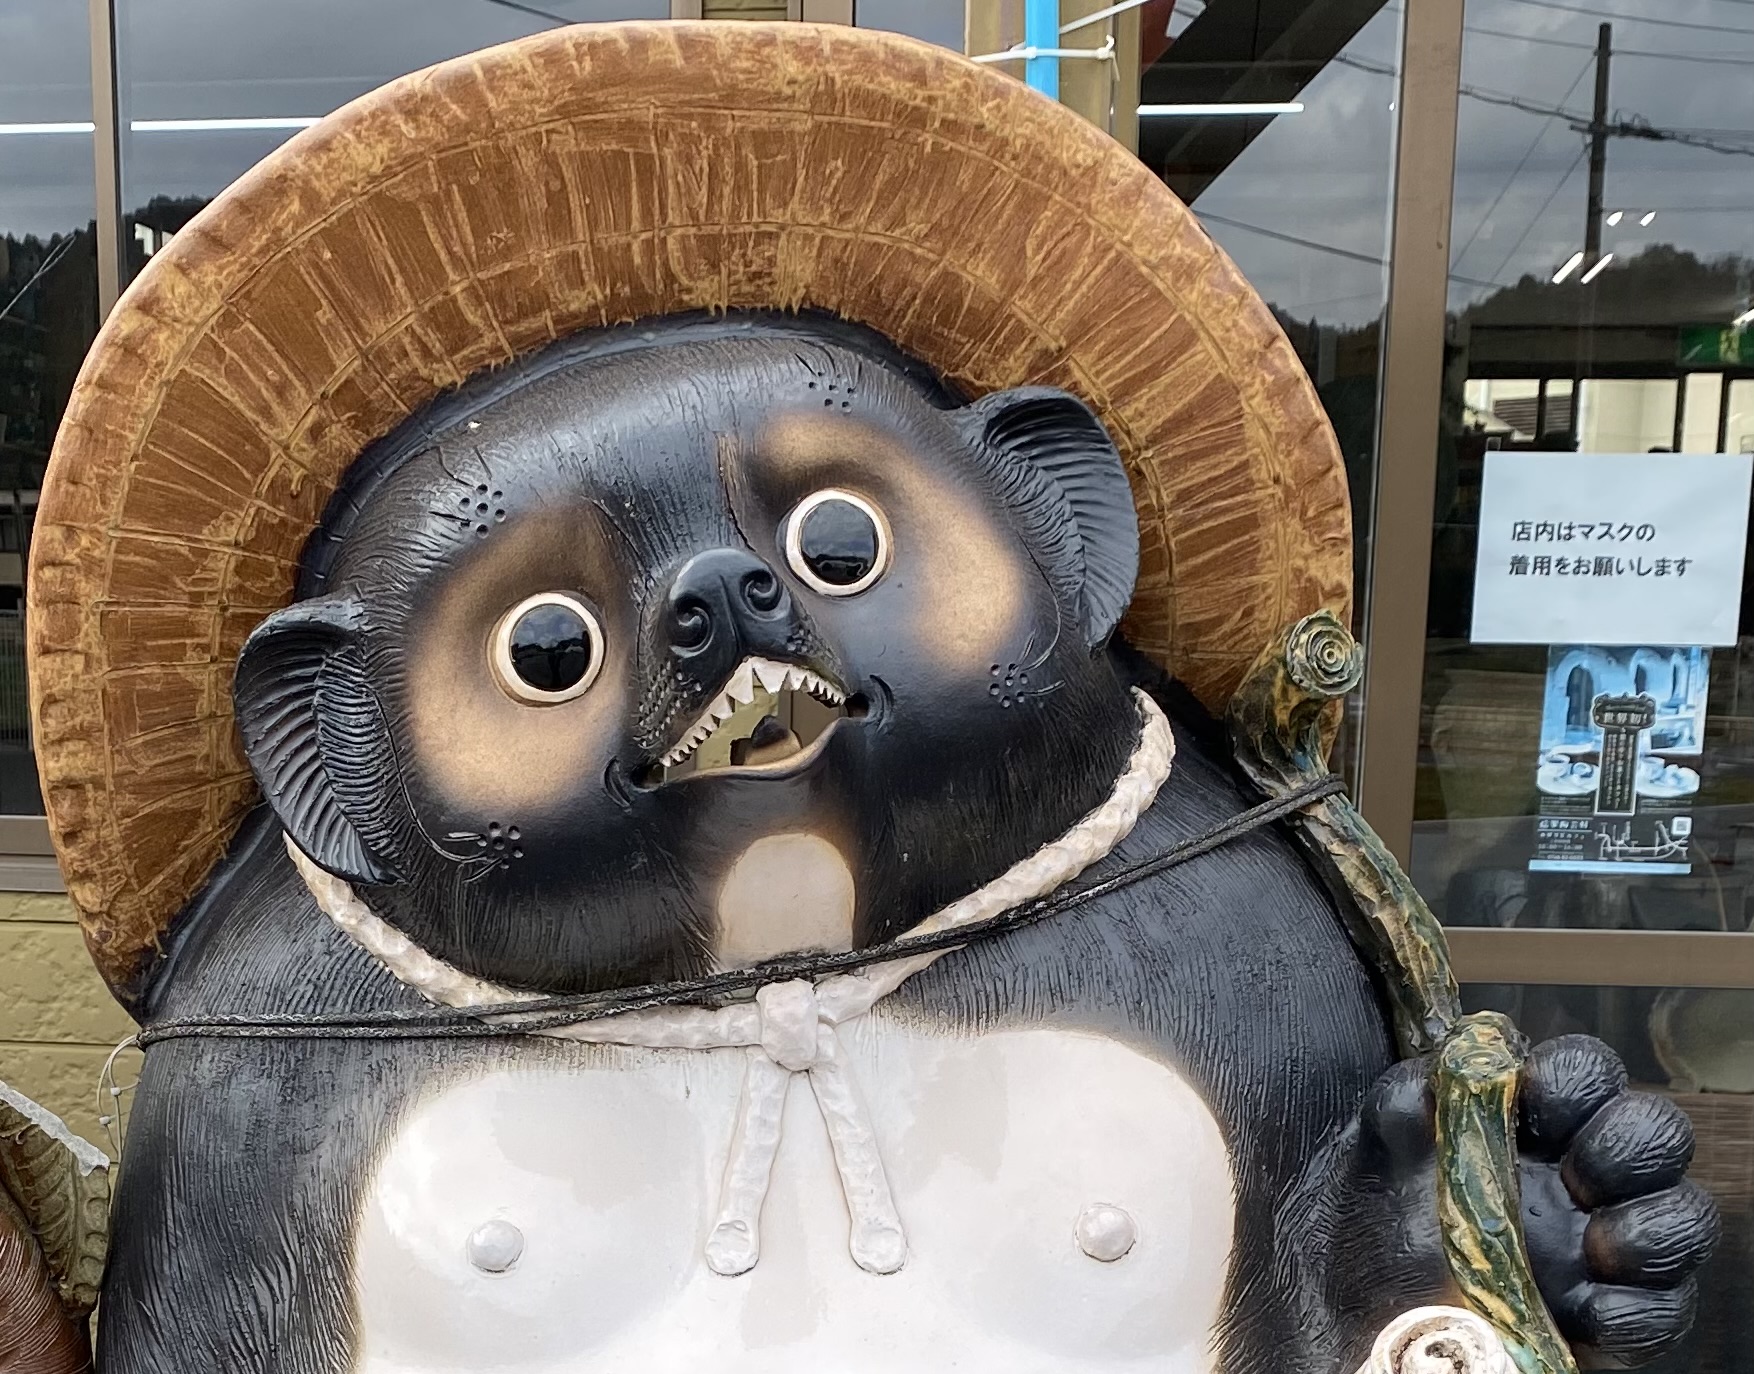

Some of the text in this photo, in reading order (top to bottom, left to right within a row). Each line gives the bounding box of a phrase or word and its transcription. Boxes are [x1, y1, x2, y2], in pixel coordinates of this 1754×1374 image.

[1512, 520, 1656, 542] 店内はマスクの
[1509, 554, 1693, 576] 着用をお願いします
